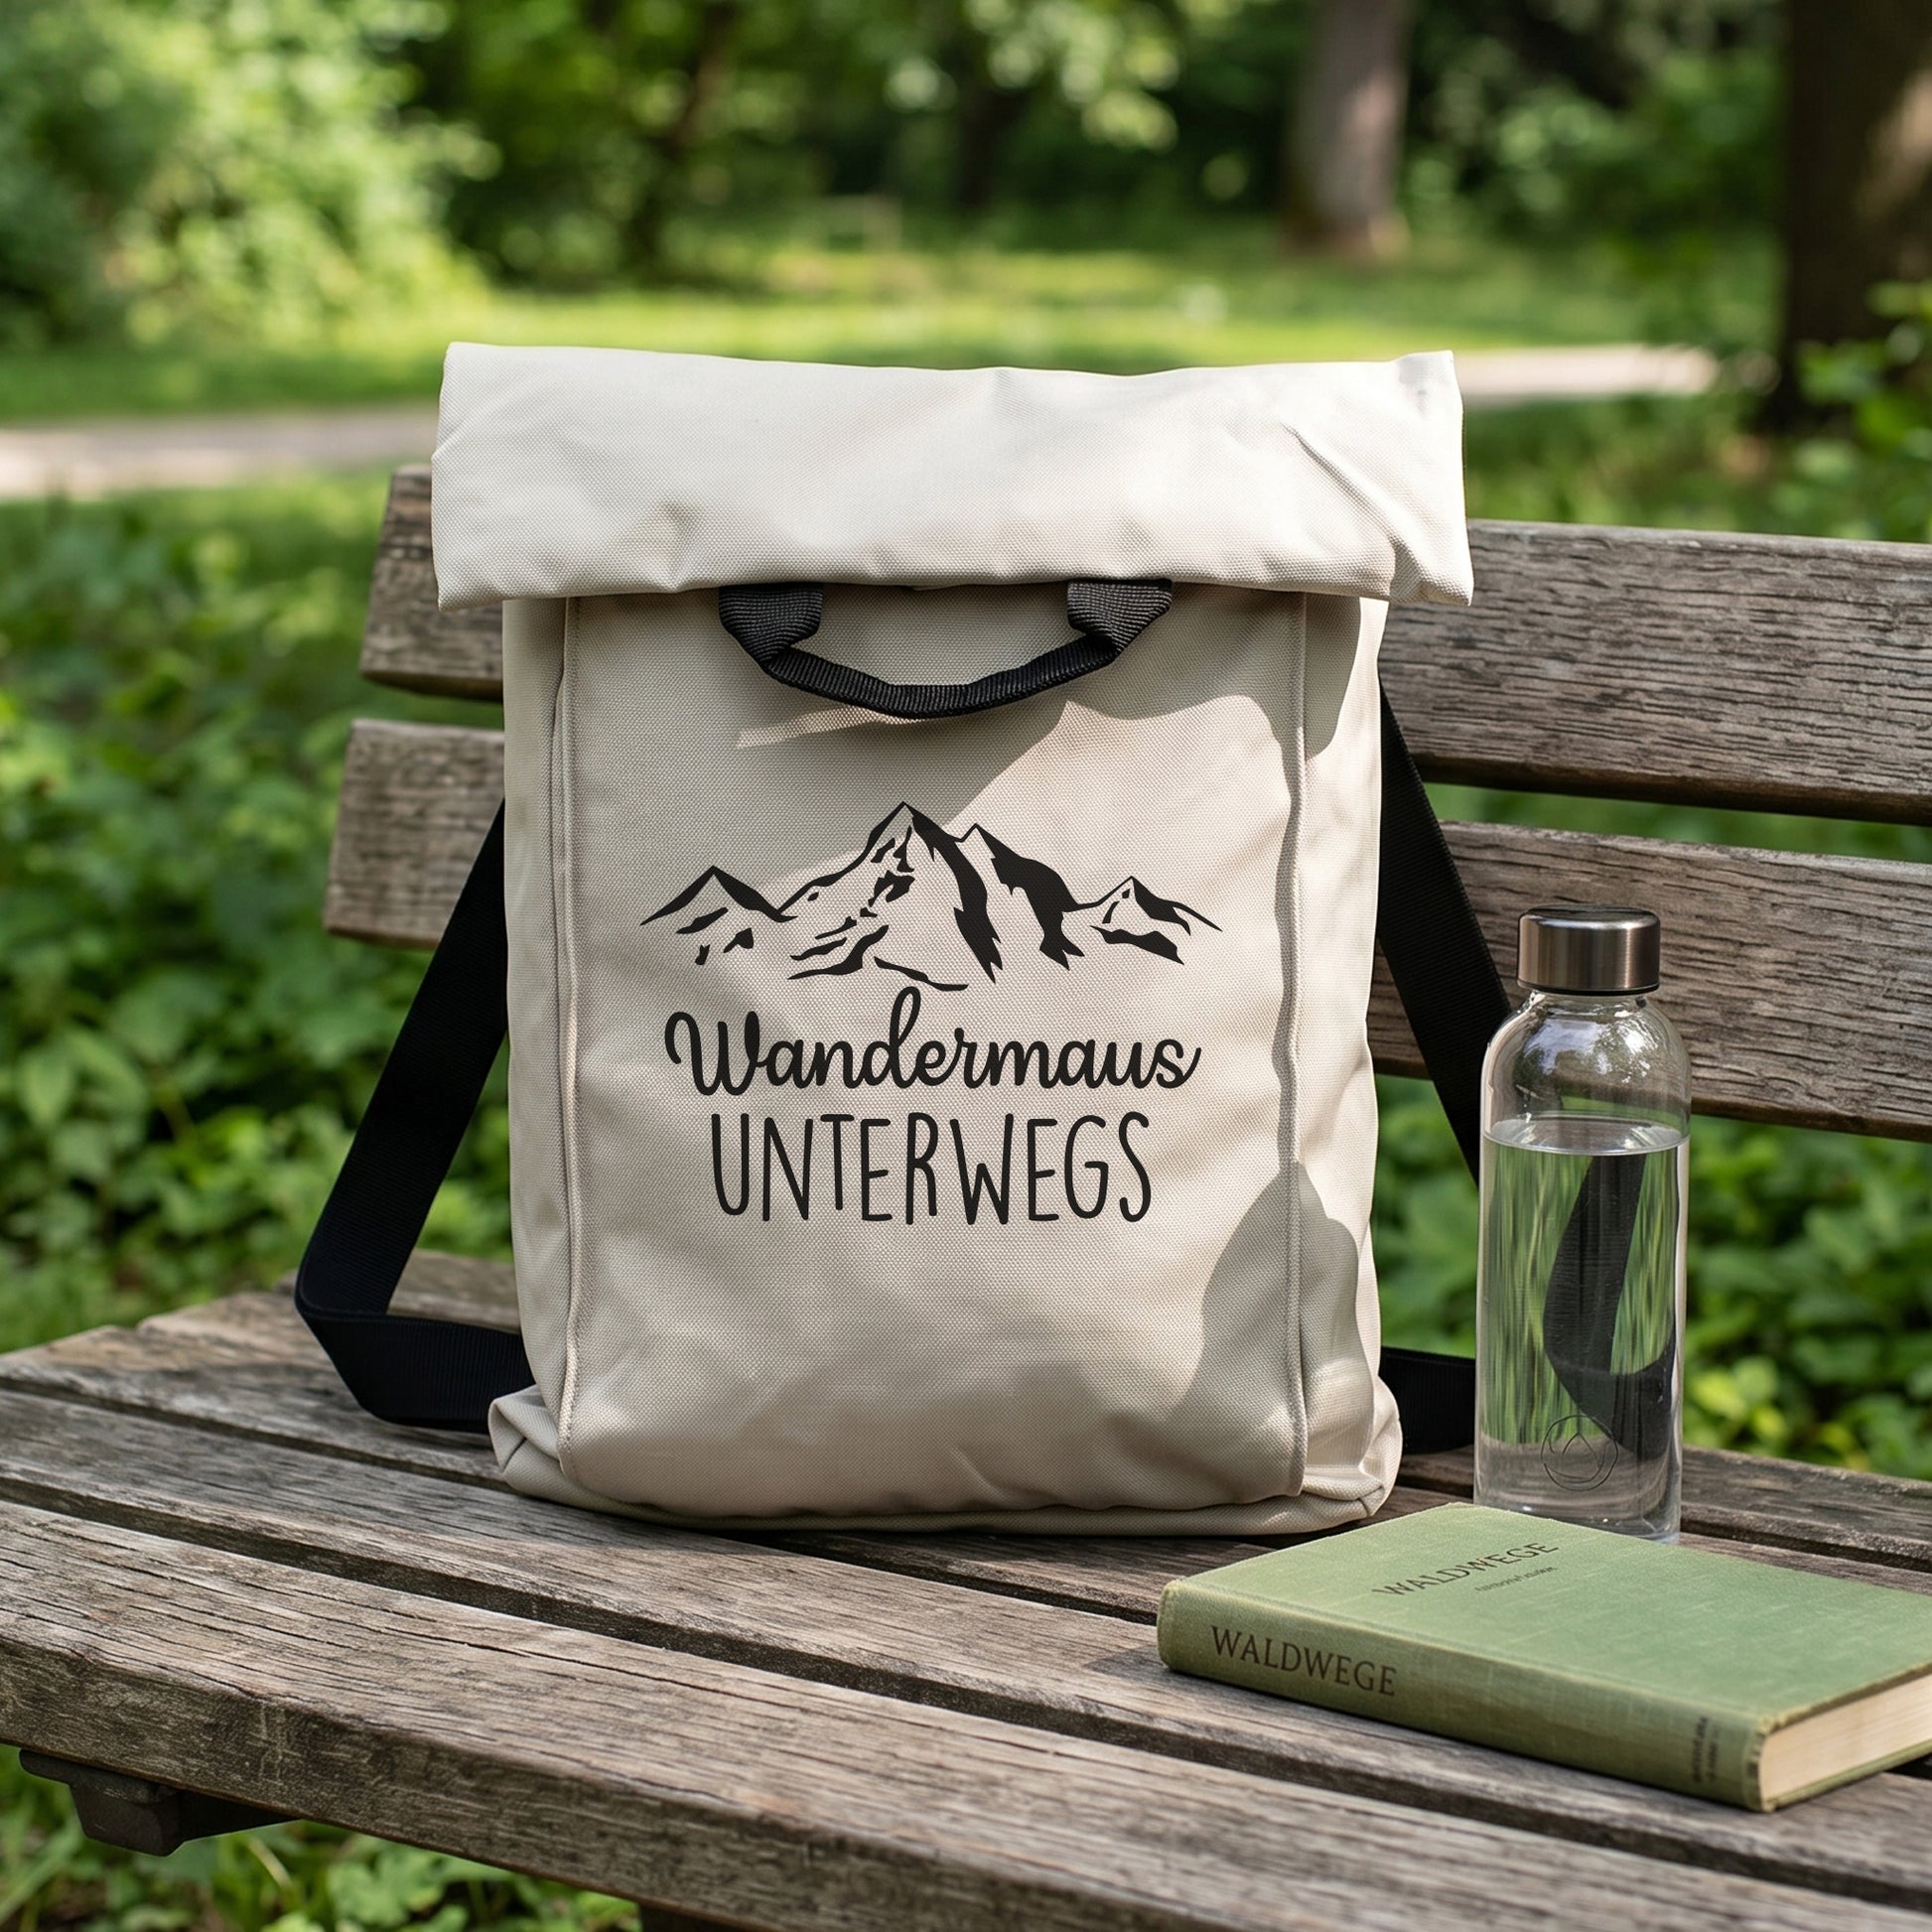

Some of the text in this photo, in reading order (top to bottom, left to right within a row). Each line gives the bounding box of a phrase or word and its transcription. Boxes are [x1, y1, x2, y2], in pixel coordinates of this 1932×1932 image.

[664, 986, 1202, 1096] Wandermaus
[711, 1111, 1152, 1226] UNTERWEGS
[1372, 1542, 1559, 1595] WALDWEGE
[1210, 1624, 1398, 1697] WALDWEGE
